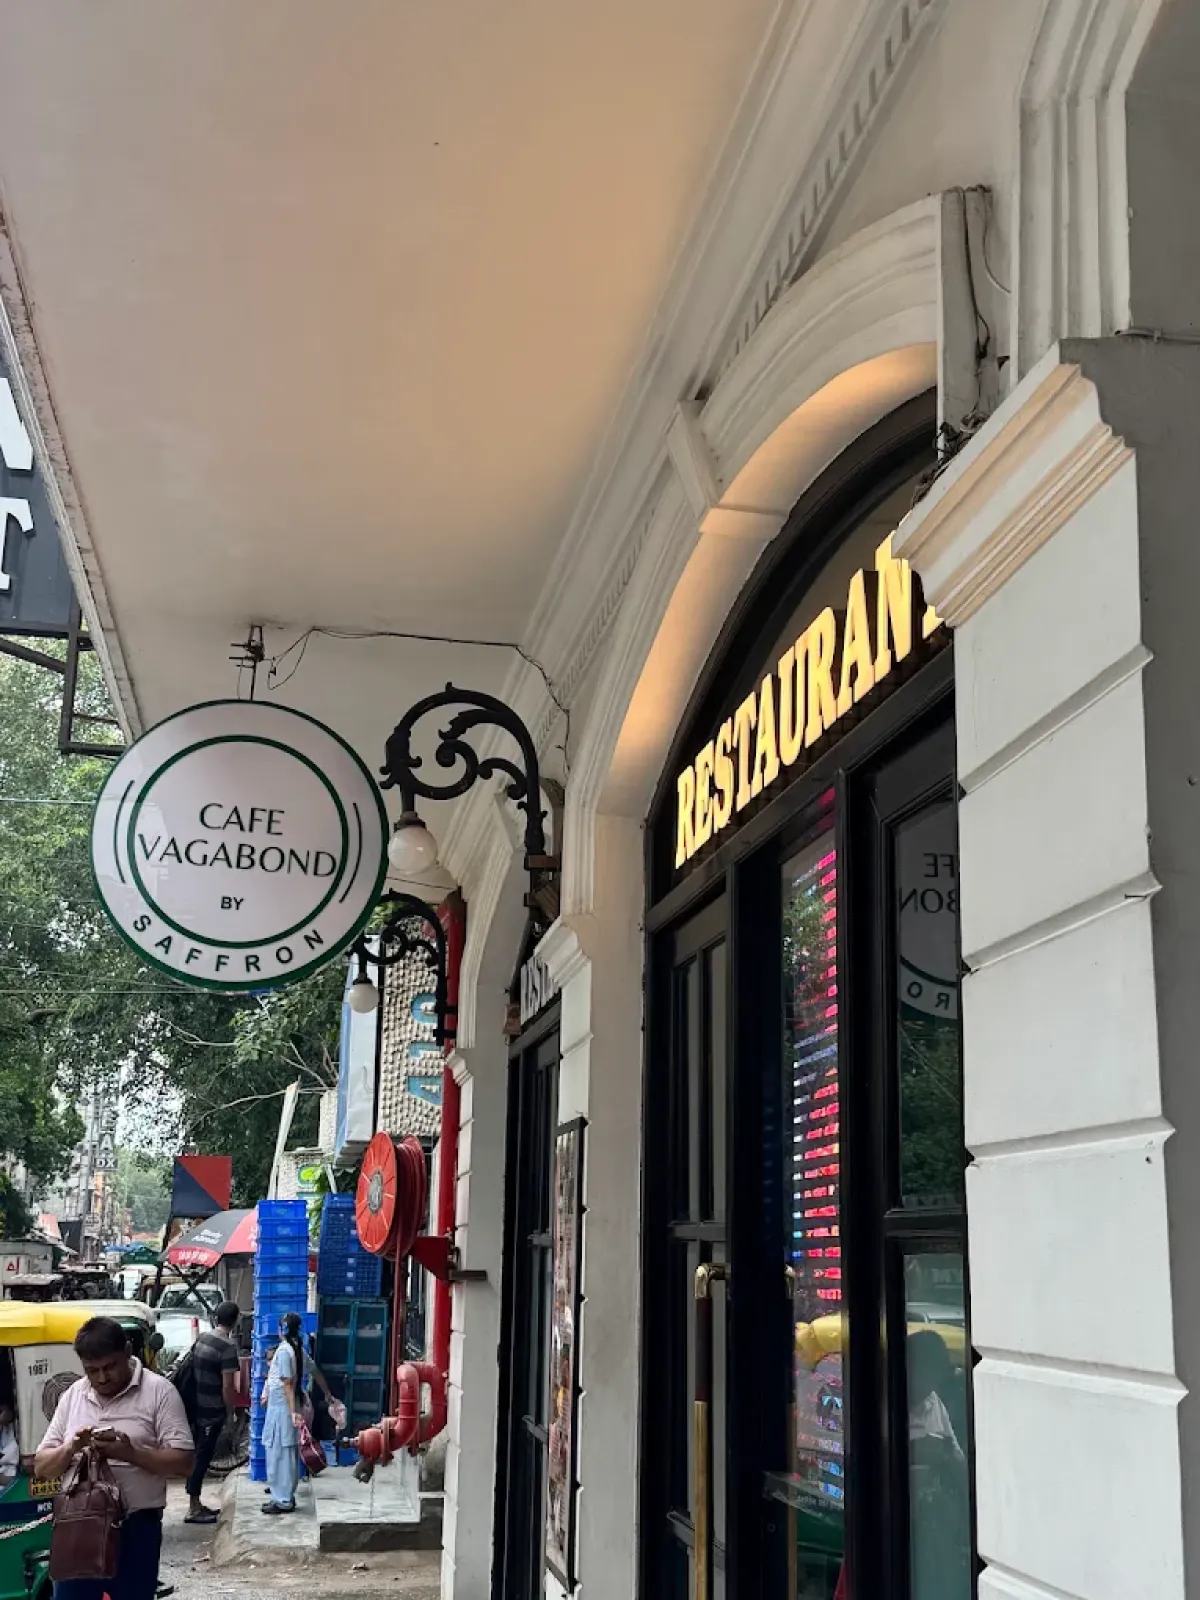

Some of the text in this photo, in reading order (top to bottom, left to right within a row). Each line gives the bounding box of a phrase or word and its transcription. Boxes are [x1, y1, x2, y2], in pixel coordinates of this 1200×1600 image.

[674, 530, 945, 870] RESTAURAN
[199, 802, 285, 836] CAFE
[137, 832, 338, 878] VAGABOND
[220, 895, 244, 911] BY
[132, 913, 325, 974] SAFFRON
